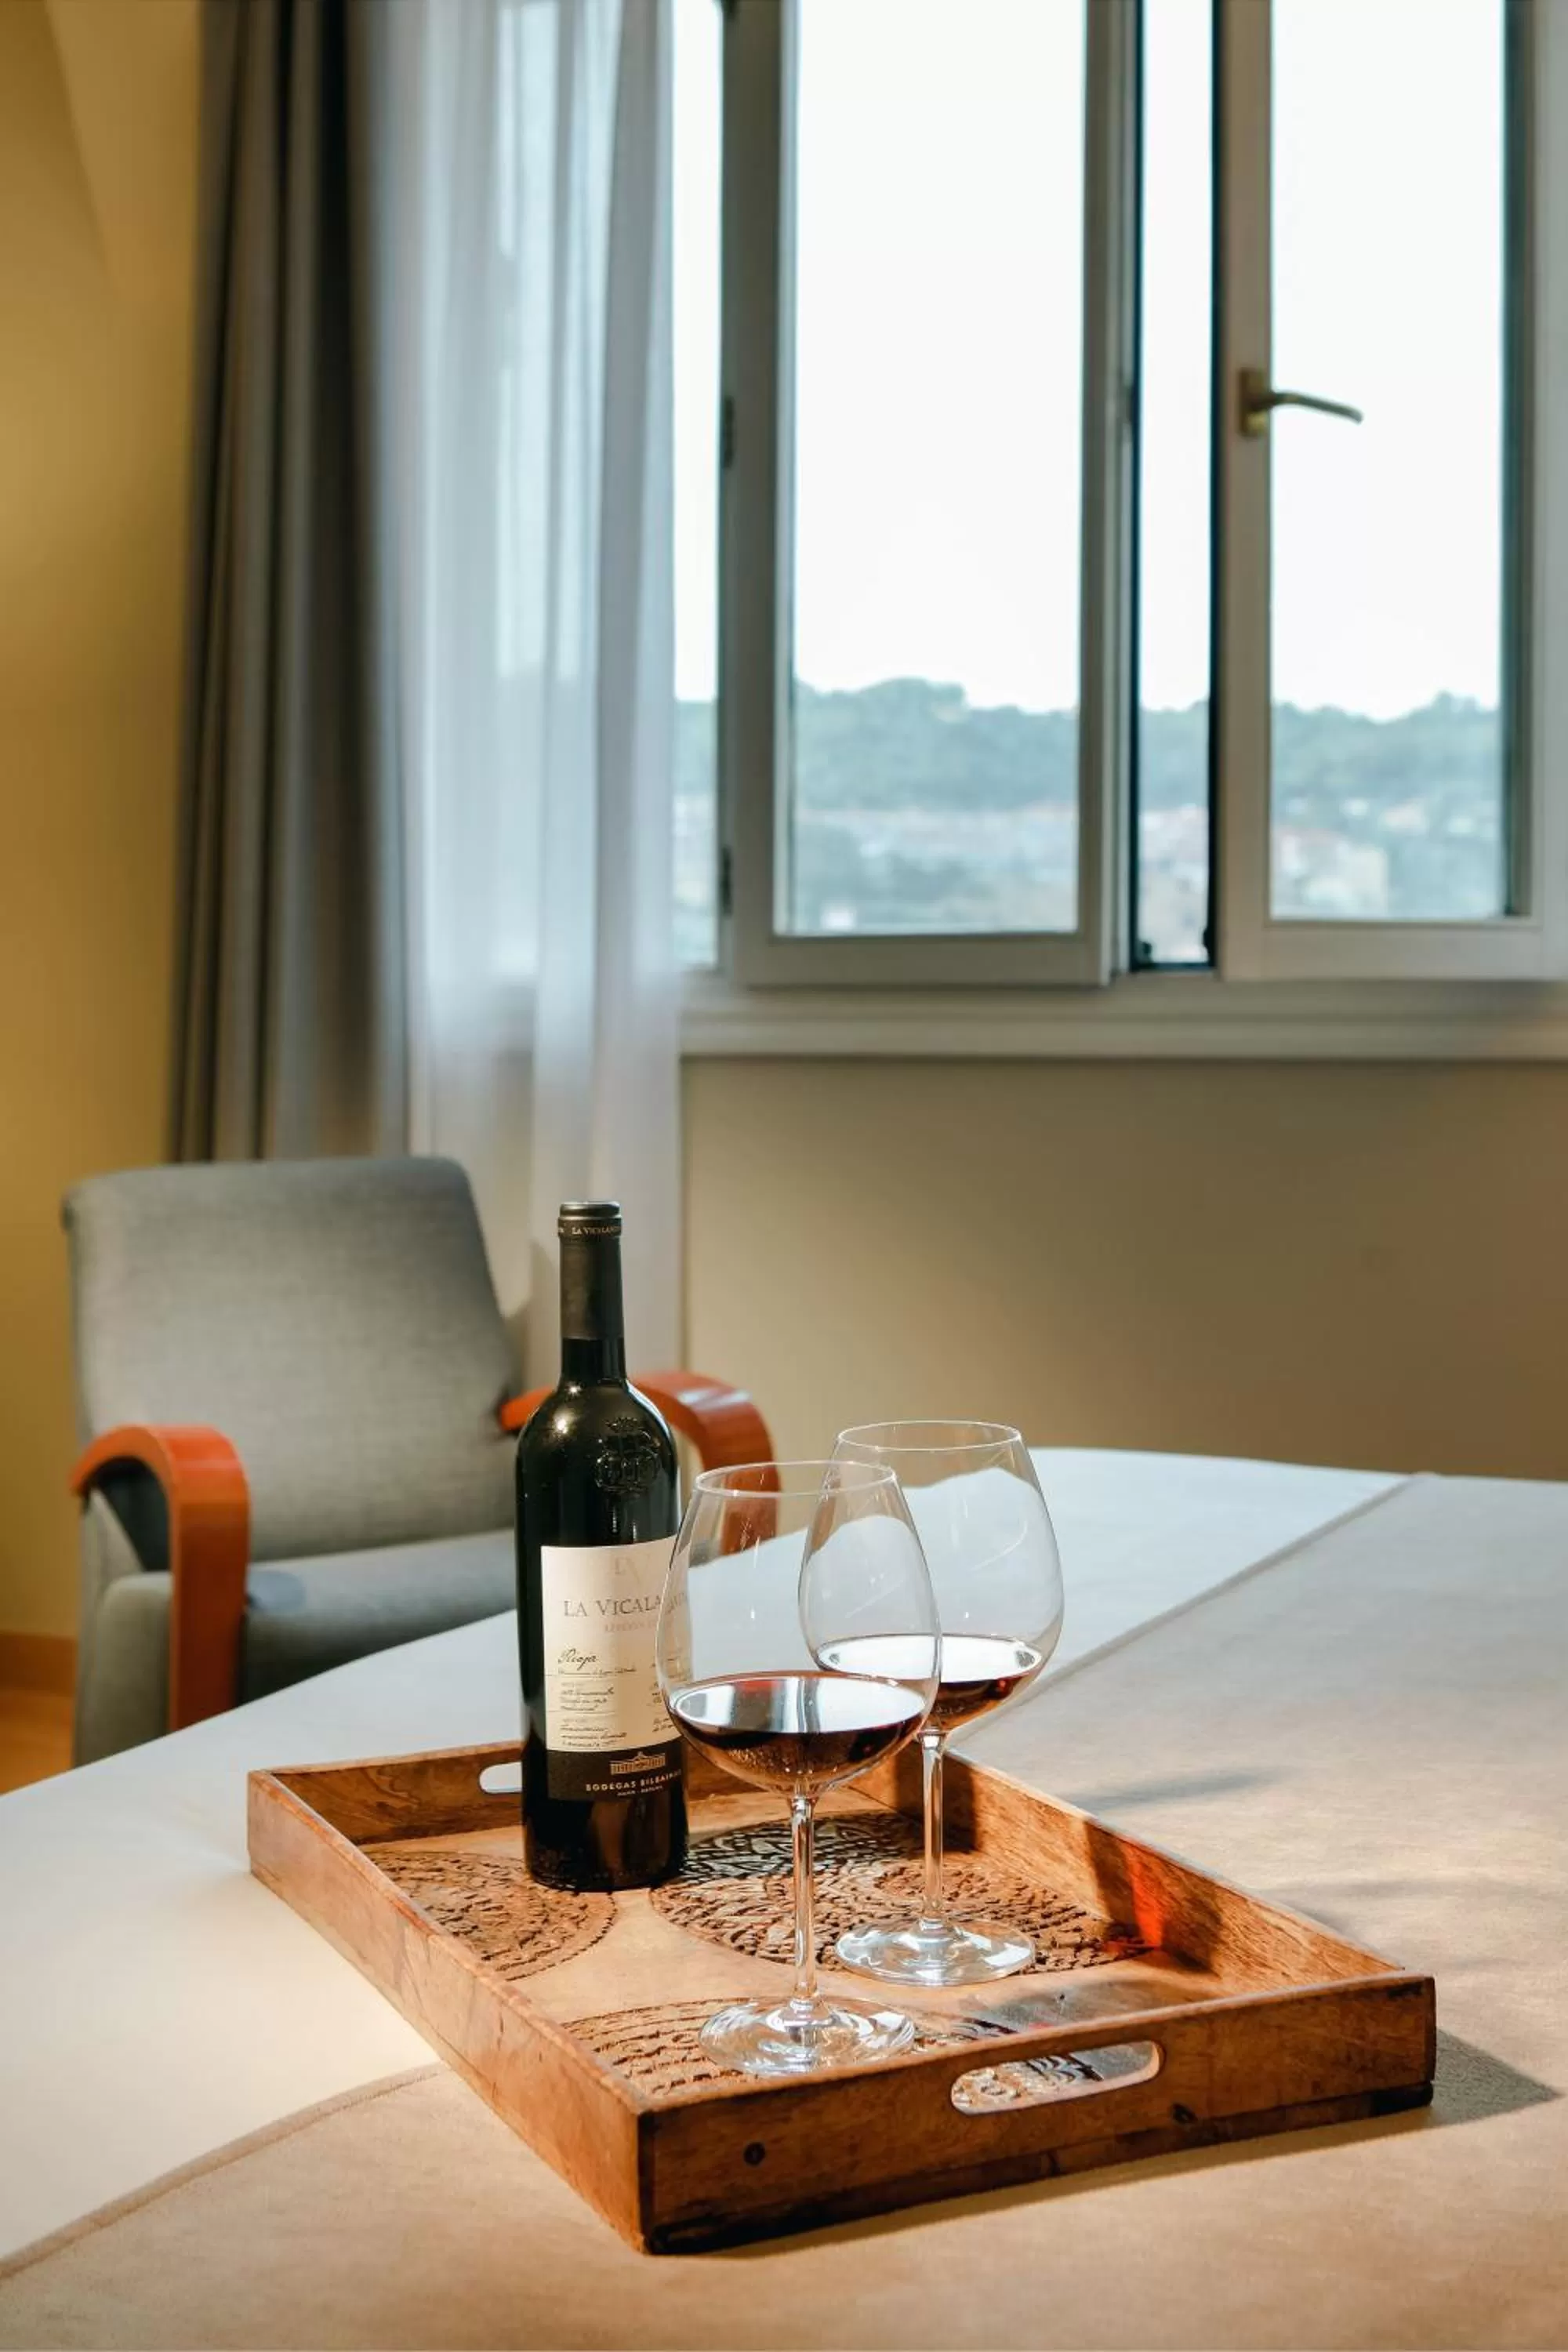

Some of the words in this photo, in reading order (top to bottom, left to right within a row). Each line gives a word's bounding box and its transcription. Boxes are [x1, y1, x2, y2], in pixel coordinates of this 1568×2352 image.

[571, 1226, 583, 1235] LA
[563, 1600, 588, 1617] LA
[557, 1648, 597, 1671] Rioja
[585, 1780, 637, 1791] BODEGAS
